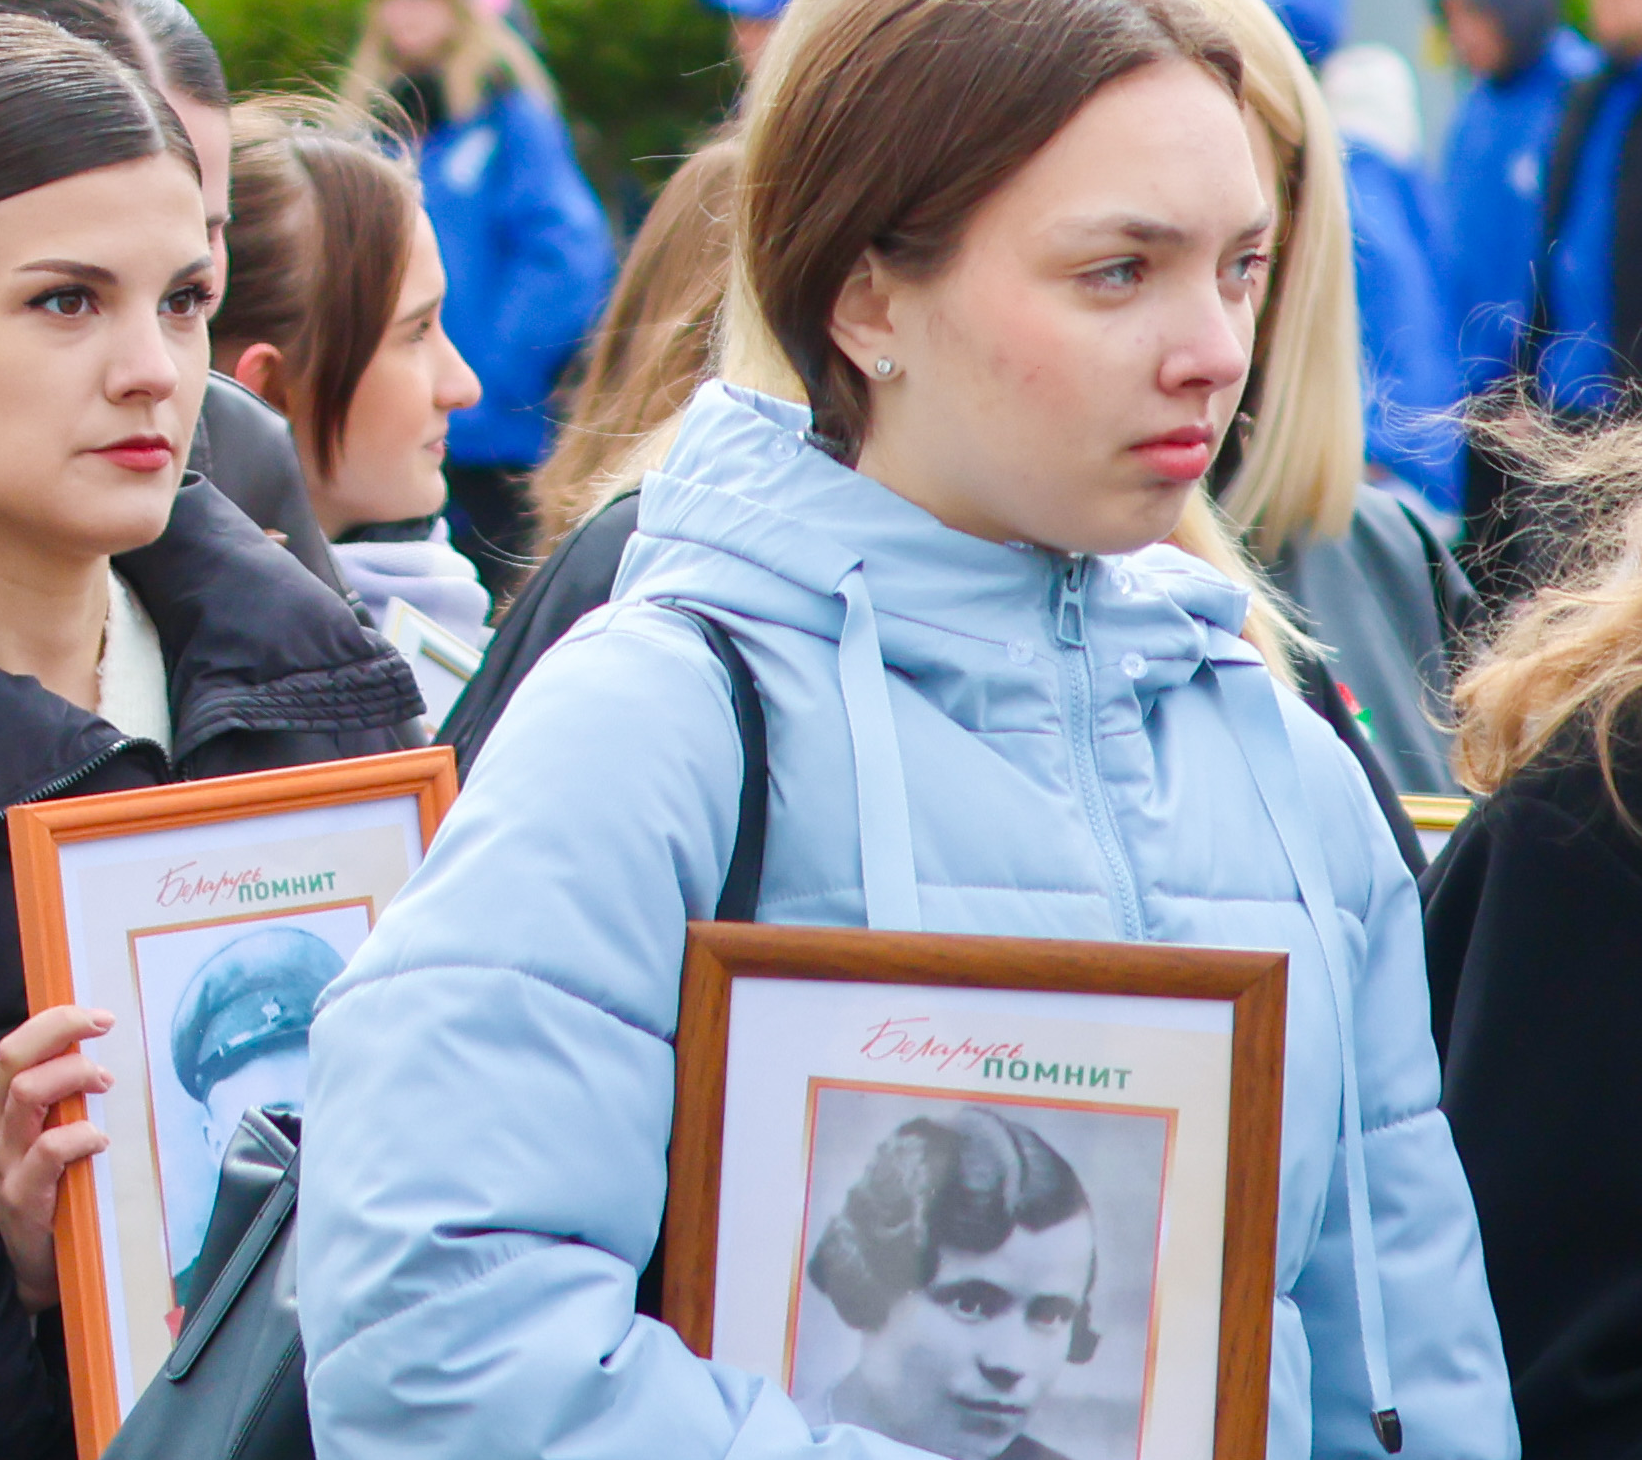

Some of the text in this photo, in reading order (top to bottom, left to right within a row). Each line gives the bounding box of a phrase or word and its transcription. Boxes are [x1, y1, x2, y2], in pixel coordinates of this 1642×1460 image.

[156, 861, 262, 907] Беларусь
[238, 871, 336, 903] ПОМНИТ
[860, 1016, 1024, 1071] Беларусь
[983, 1057, 1132, 1089] ПОМНИТ
